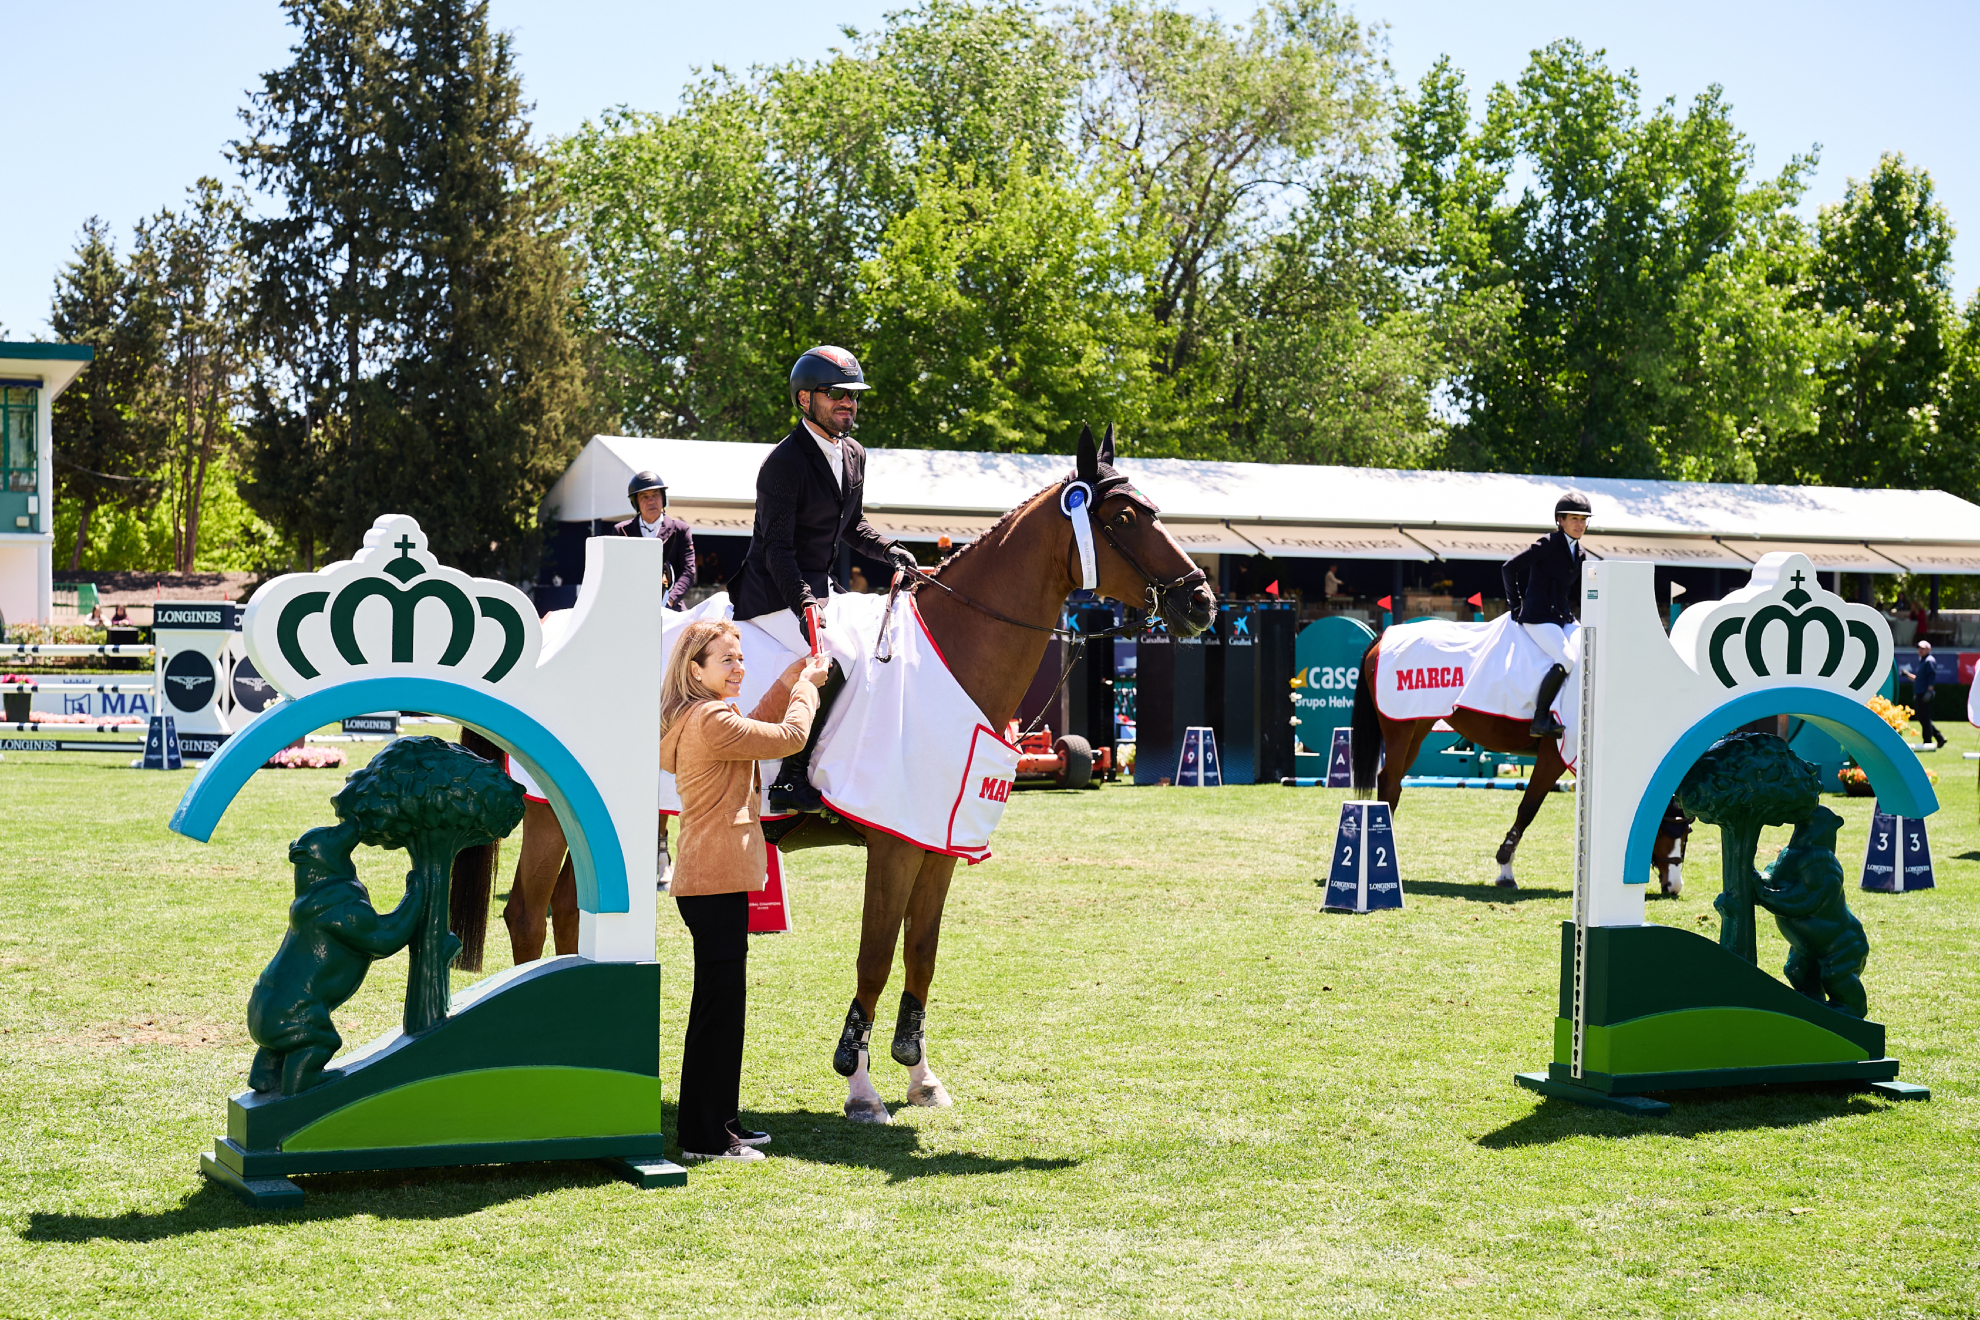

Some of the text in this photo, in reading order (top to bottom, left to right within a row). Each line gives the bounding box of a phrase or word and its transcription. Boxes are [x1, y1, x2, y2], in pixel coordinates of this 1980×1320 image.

[1264, 537, 1402, 549] LONGINES
[157, 610, 222, 623] LONGINES
[1308, 666, 1360, 690] case
[1396, 667, 1464, 691] MARCA
[1295, 697, 1326, 710] Grupo
[345, 719, 391, 731] LONGINES
[0, 739, 57, 751] LONGINES
[151, 737, 159, 748] 6
[169, 737, 175, 748] 6
[1187, 751, 1195, 764] 9
[1206, 751, 1213, 764] 9
[1336, 753, 1346, 765] A
[1877, 832, 1889, 851] 3
[1909, 833, 1921, 852] 3
[1341, 845, 1353, 866] 2
[1376, 846, 1388, 867] 2
[1331, 880, 1356, 889] LONGINES
[1369, 882, 1397, 890] LONGINES
